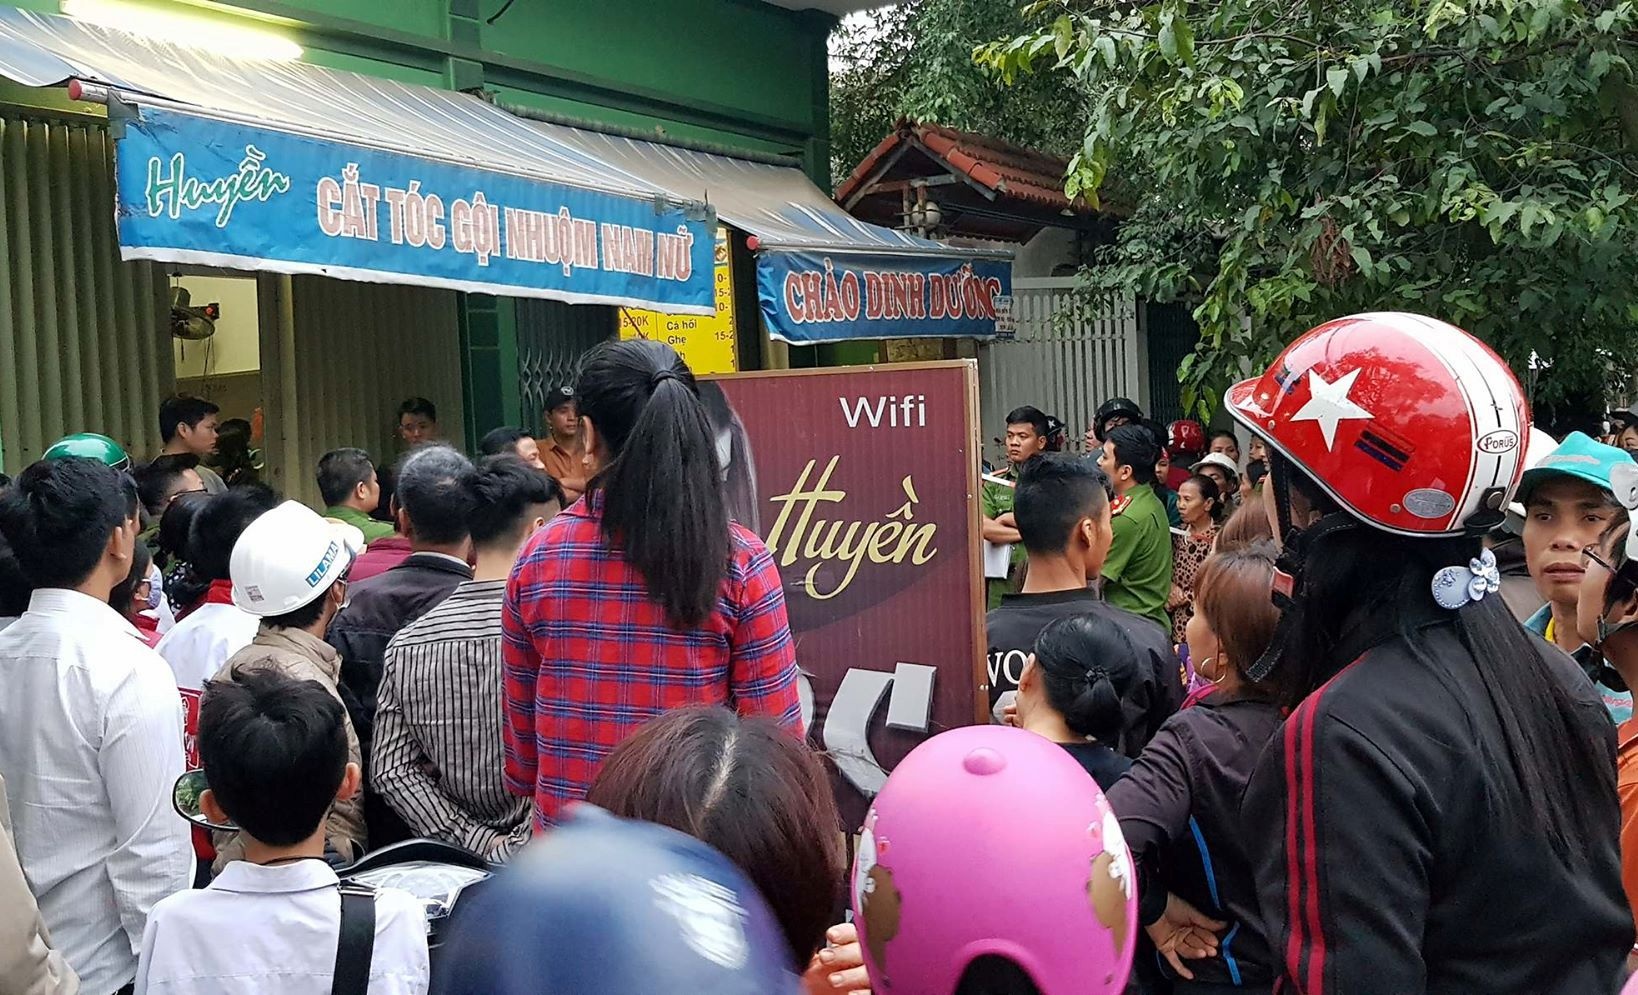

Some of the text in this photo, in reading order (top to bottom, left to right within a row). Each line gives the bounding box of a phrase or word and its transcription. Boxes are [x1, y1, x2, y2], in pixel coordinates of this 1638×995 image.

[145, 145, 289, 227] Huyền
[317, 162, 693, 282] CẮT TÓC GỘI NHUỘM NAM NỮ
[863, 271, 926, 320] DINH
[839, 394, 926, 428] Wifi
[766, 455, 937, 600] Huyền
[307, 541, 339, 586] LILAMA
